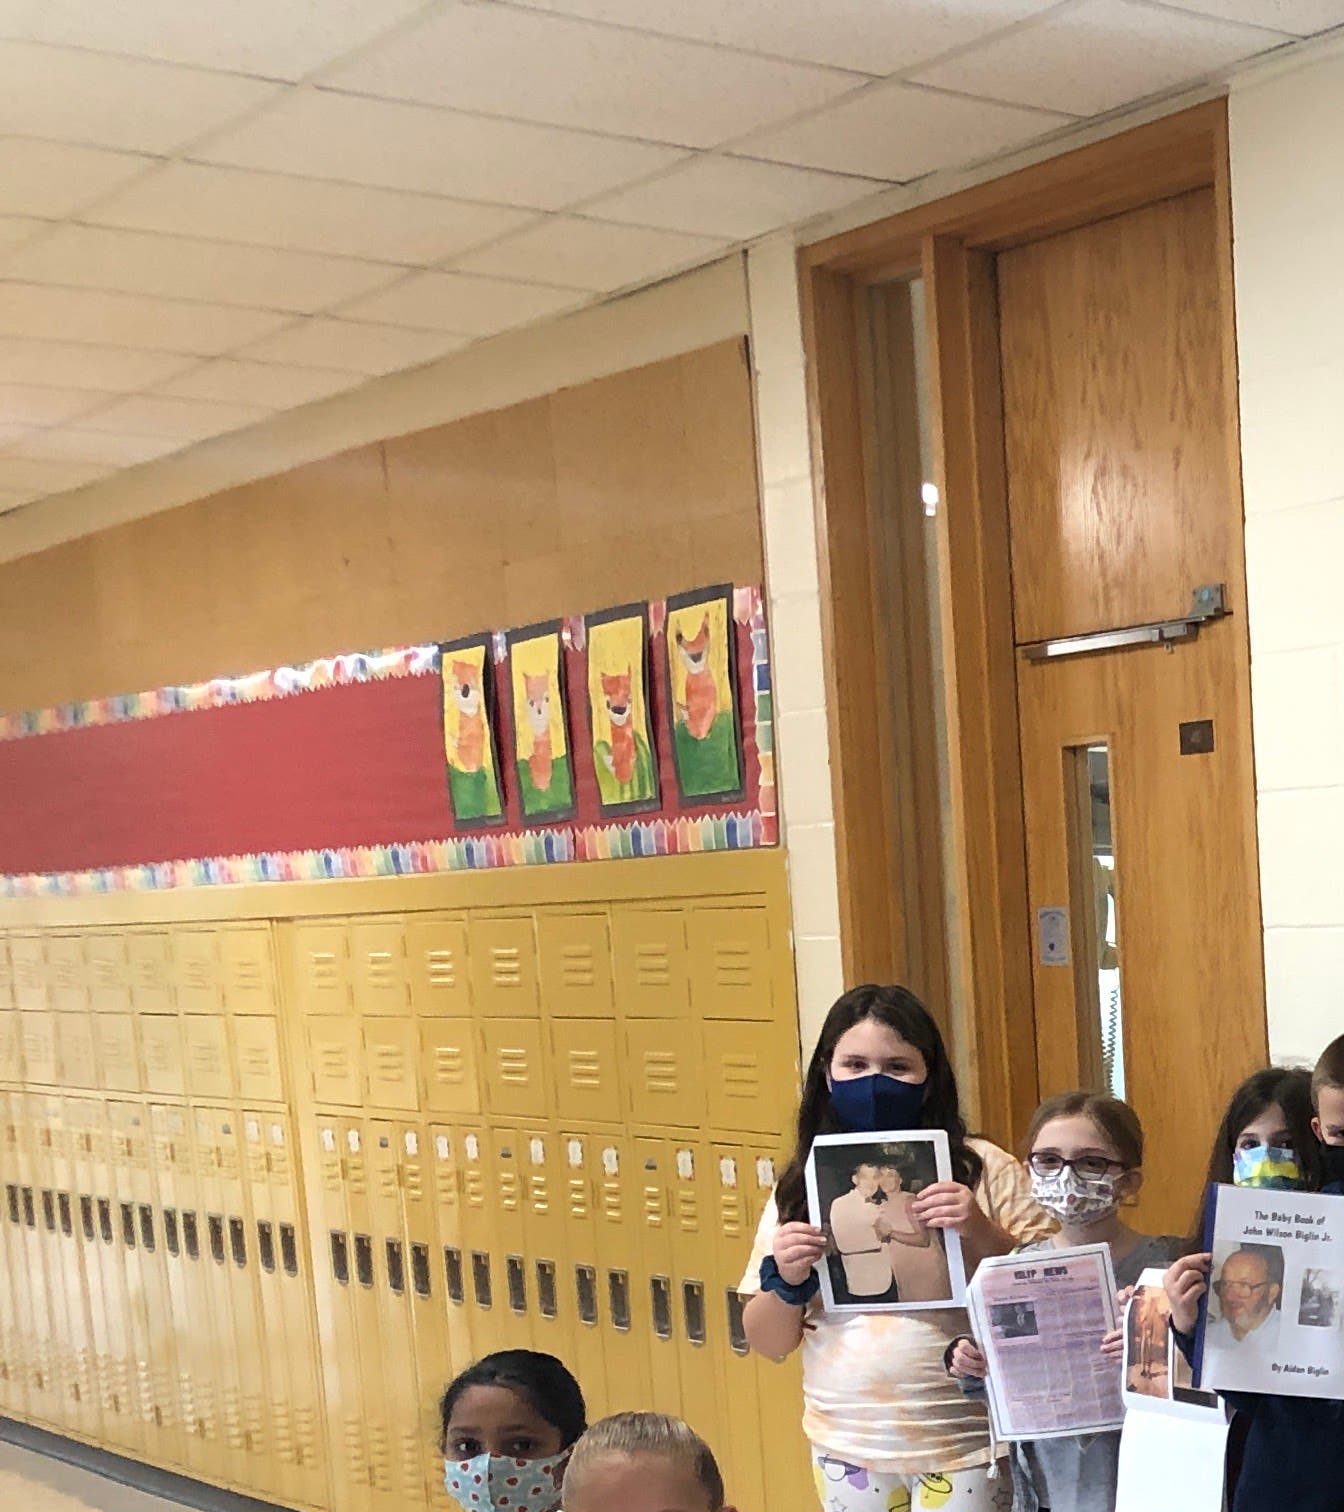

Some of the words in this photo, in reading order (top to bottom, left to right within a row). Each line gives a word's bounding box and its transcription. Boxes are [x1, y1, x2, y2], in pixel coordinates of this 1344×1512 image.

[1254, 1210, 1269, 1221] The
[1271, 1212, 1292, 1225] Baby
[1294, 1214, 1314, 1225] Book
[1316, 1215, 1326, 1225] of
[1242, 1225, 1263, 1236] John
[1265, 1228, 1293, 1239] Wilson
[1271, 1362, 1283, 1373] By
